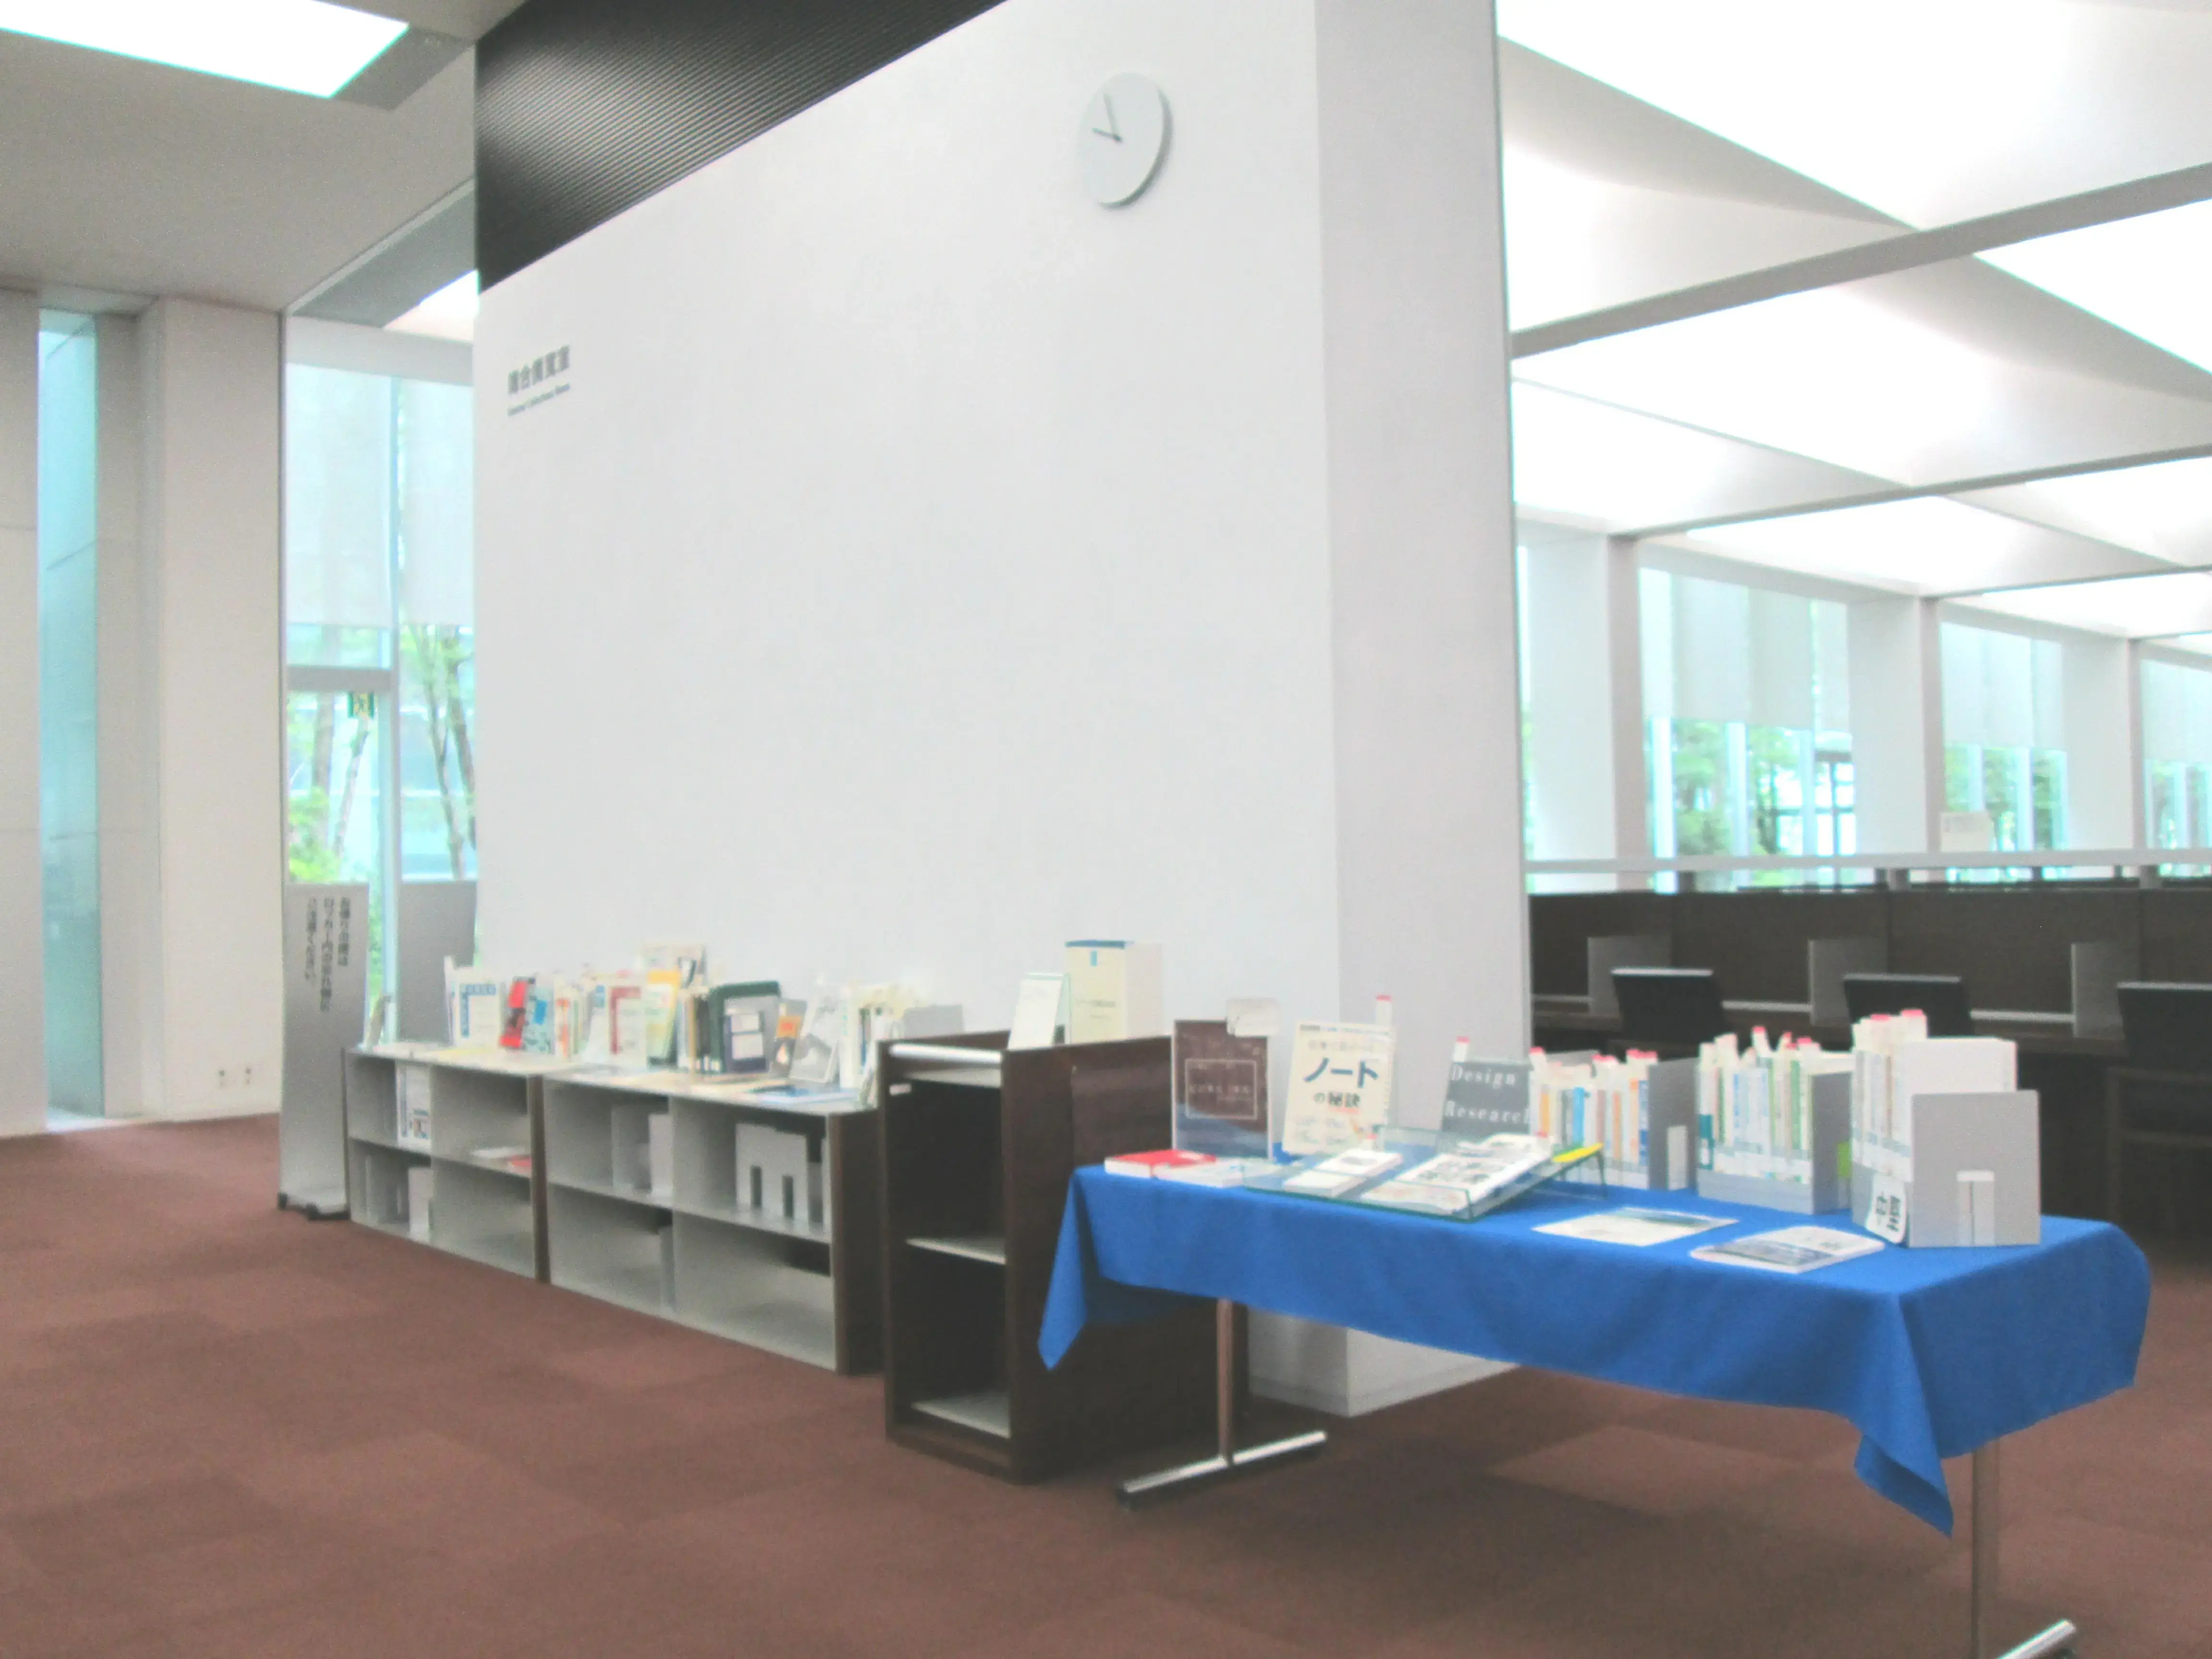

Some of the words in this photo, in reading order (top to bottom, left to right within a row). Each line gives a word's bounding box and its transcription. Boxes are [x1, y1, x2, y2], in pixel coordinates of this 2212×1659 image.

[1303, 1057, 1379, 1088] ノート
[1452, 1063, 1515, 1089] Design
